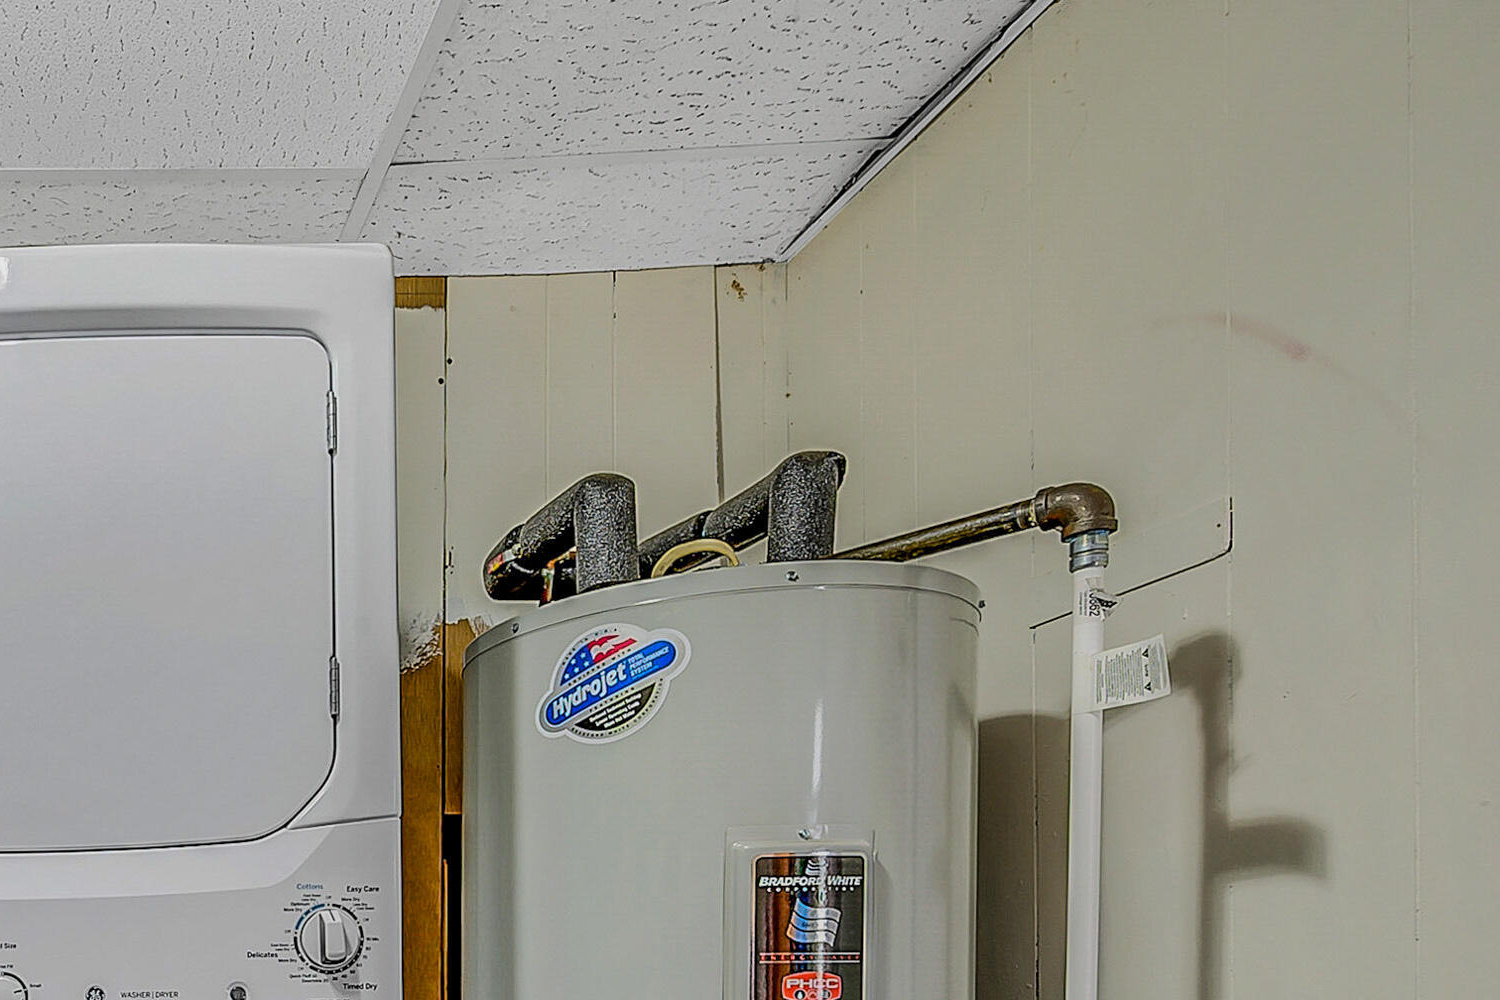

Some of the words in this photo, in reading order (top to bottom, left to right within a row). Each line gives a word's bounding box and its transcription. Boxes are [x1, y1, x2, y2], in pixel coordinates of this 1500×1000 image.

[552, 662, 628, 719] Hydrojet
[759, 876, 822, 887] BRADFORD
[827, 875, 862, 886] WHITE
[365, 983, 378, 991] Dry
[786, 978, 839, 989] PHCC
